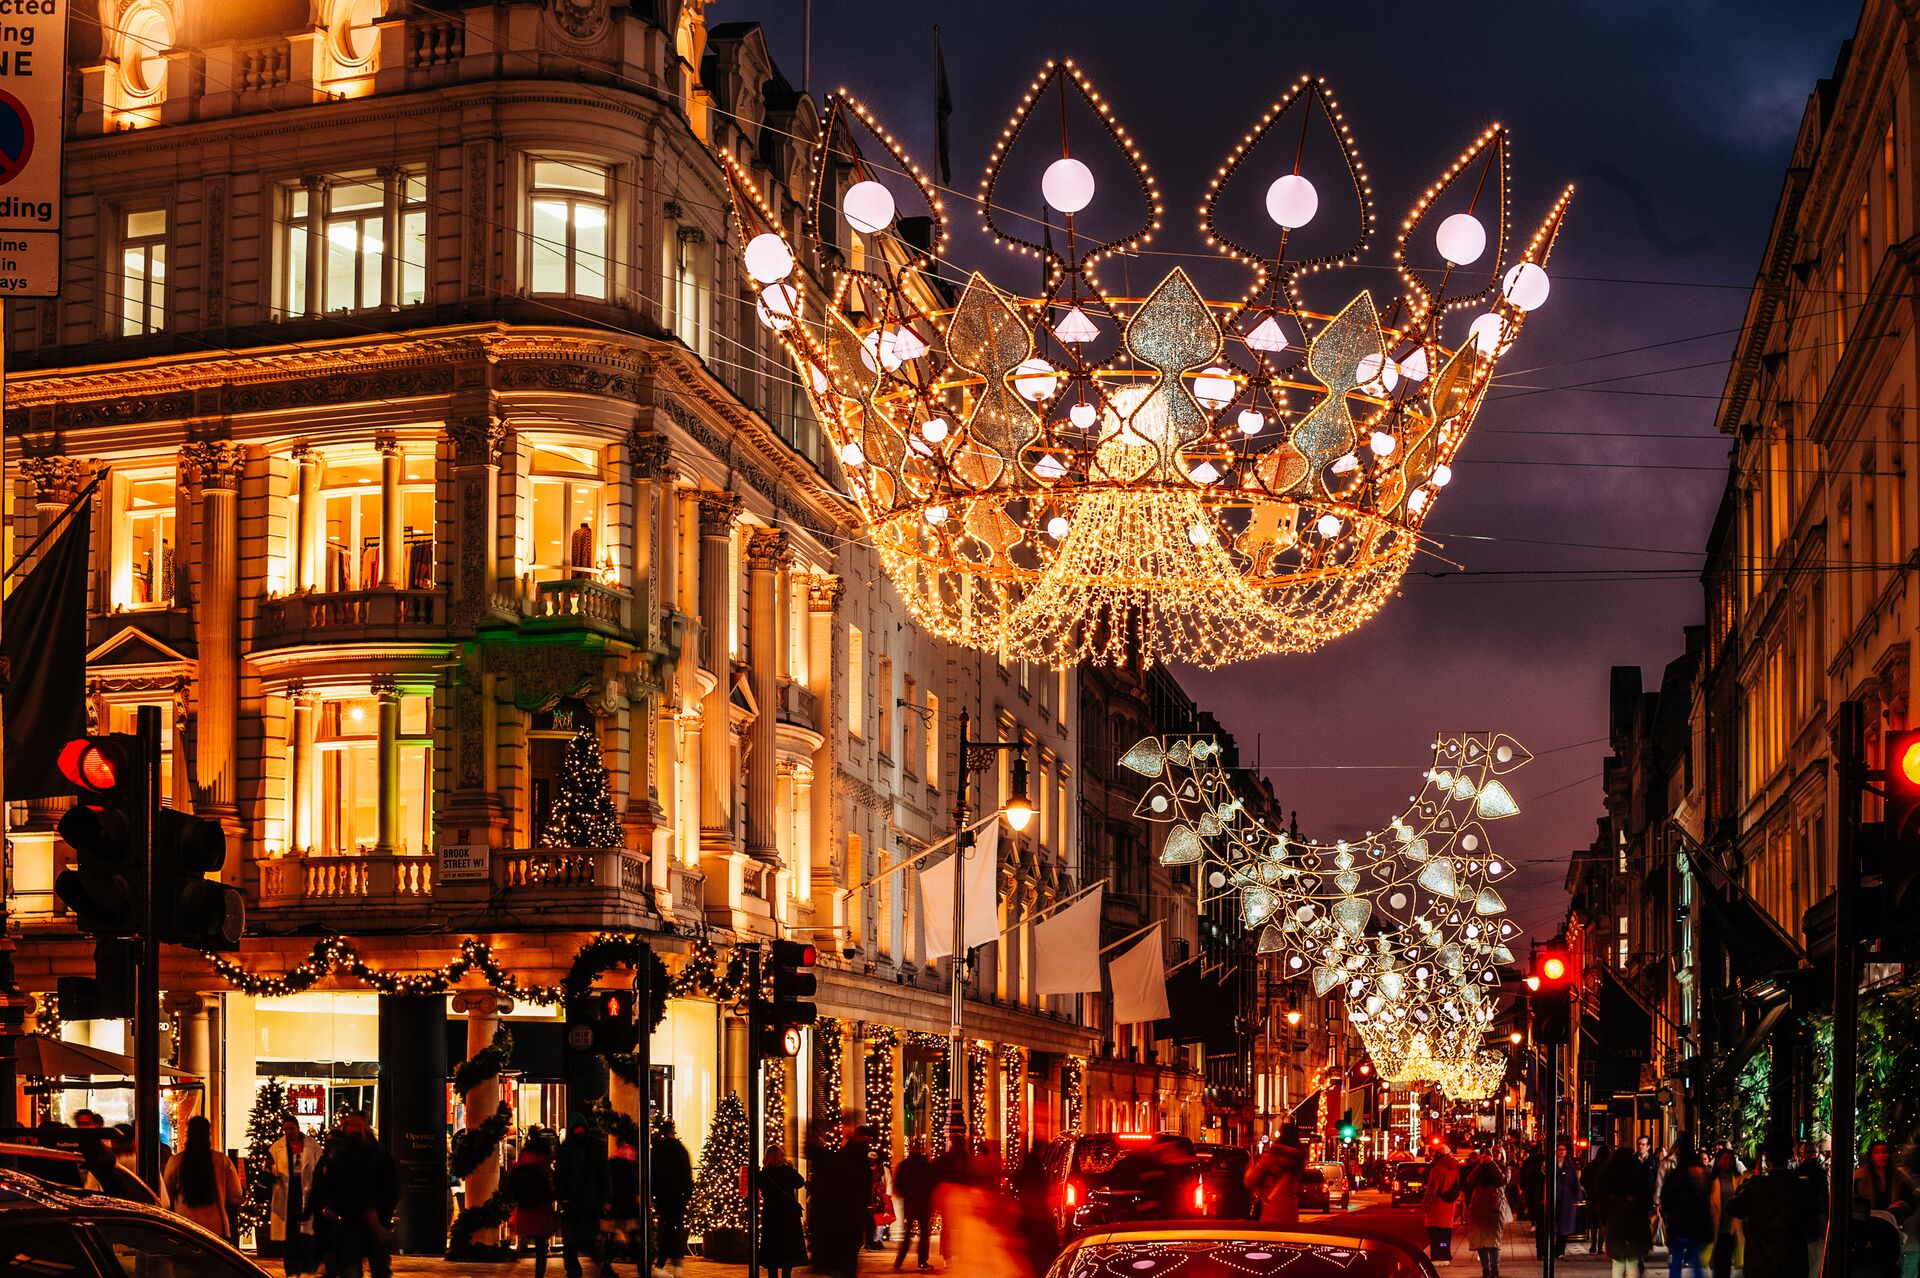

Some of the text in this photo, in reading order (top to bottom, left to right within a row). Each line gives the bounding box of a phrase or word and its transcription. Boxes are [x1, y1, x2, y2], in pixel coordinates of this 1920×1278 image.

[0, 22, 35, 46] ng
[0, 197, 52, 222] ding
[2, 257, 17, 271] in
[443, 848, 470, 858] BROOK
[443, 858, 484, 869] STREET W1
